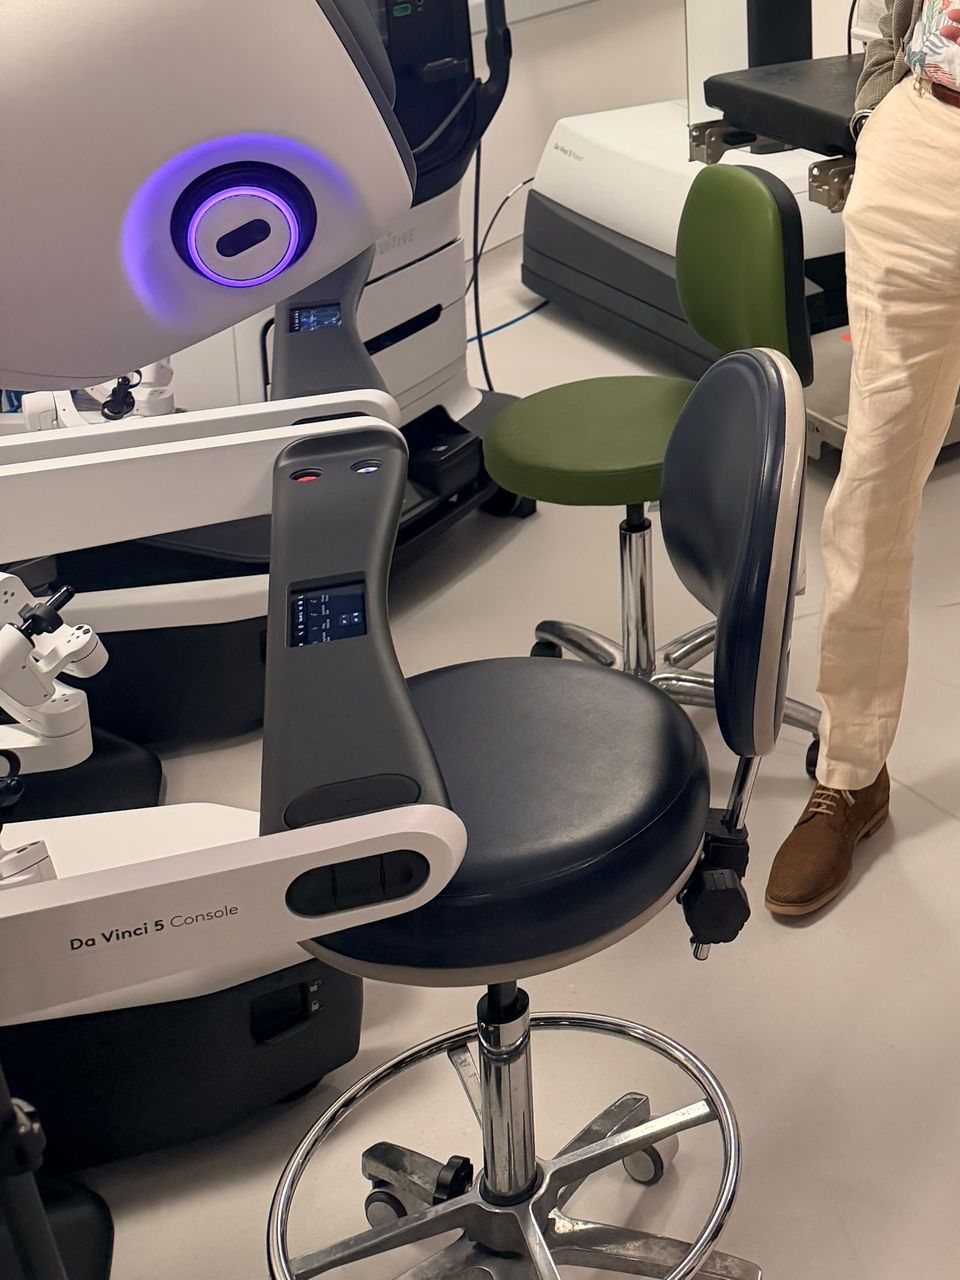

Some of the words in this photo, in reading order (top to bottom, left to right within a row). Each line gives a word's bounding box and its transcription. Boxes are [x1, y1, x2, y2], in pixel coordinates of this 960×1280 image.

[70, 937, 96, 951] Da
[101, 922, 149, 943] Vinci
[154, 919, 165, 932] 5
[170, 904, 239, 928] Console
